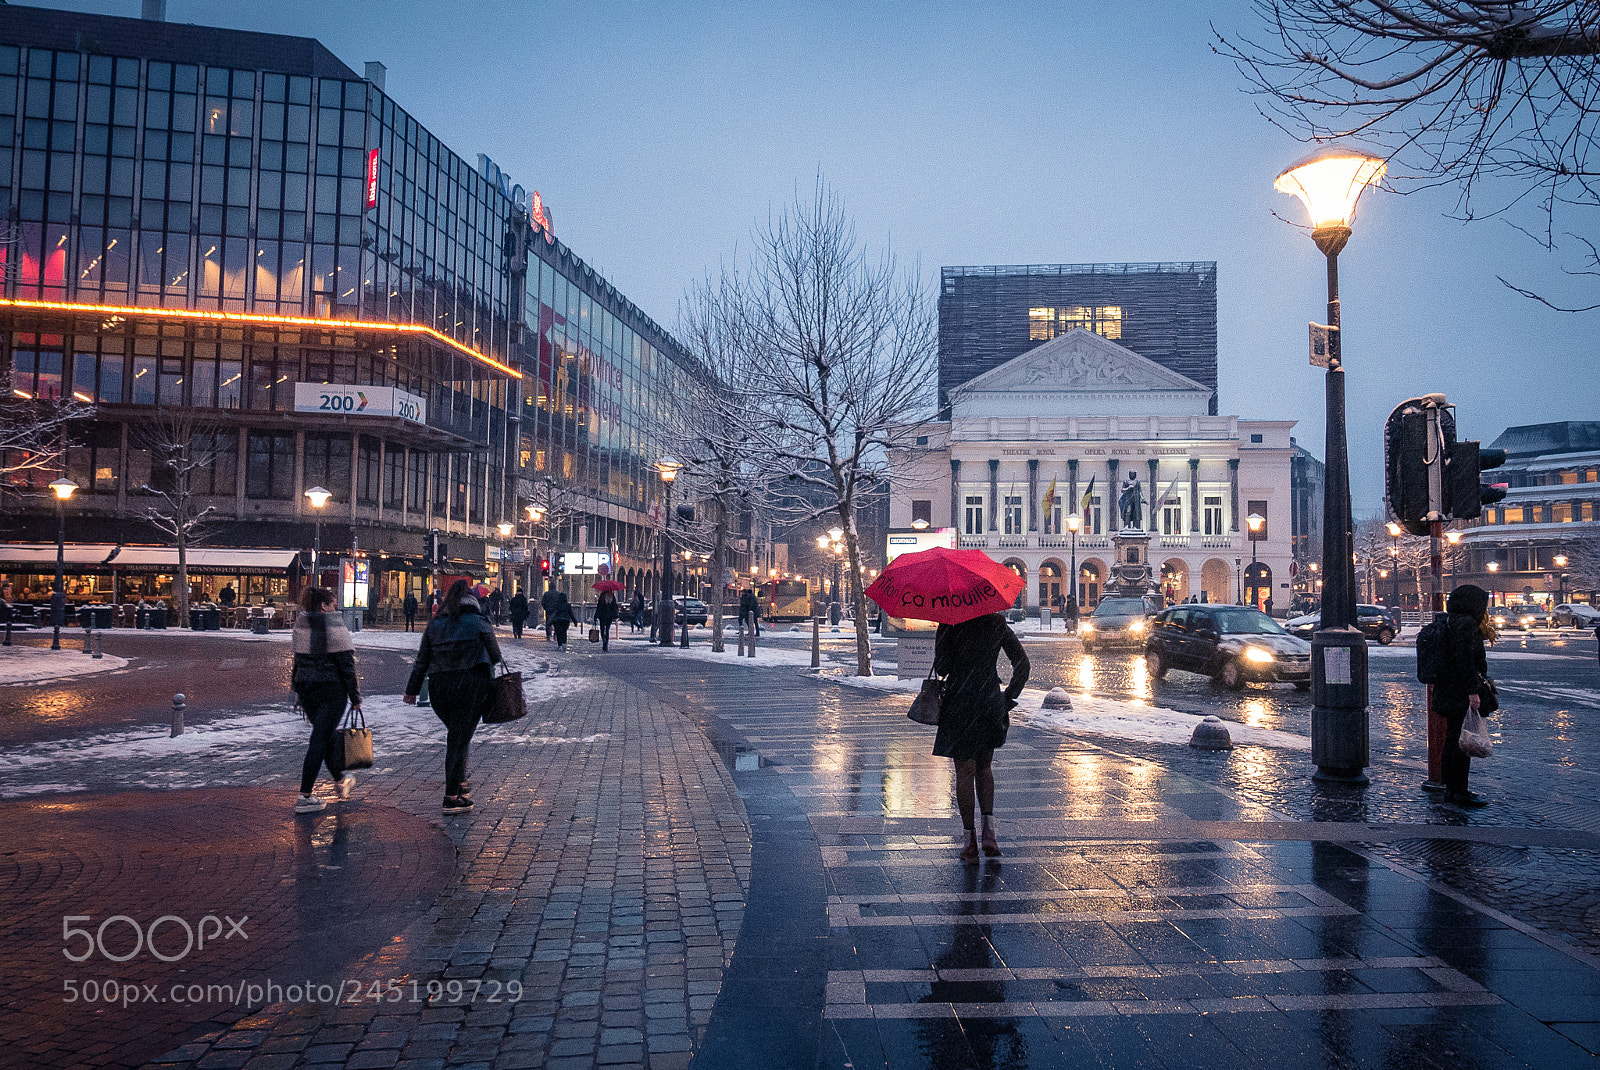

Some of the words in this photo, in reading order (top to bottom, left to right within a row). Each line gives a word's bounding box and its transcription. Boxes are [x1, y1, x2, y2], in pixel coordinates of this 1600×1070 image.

[320, 395, 353, 411] 200
[399, 401, 415, 419] 200
[931, 585, 997, 608] mouille
